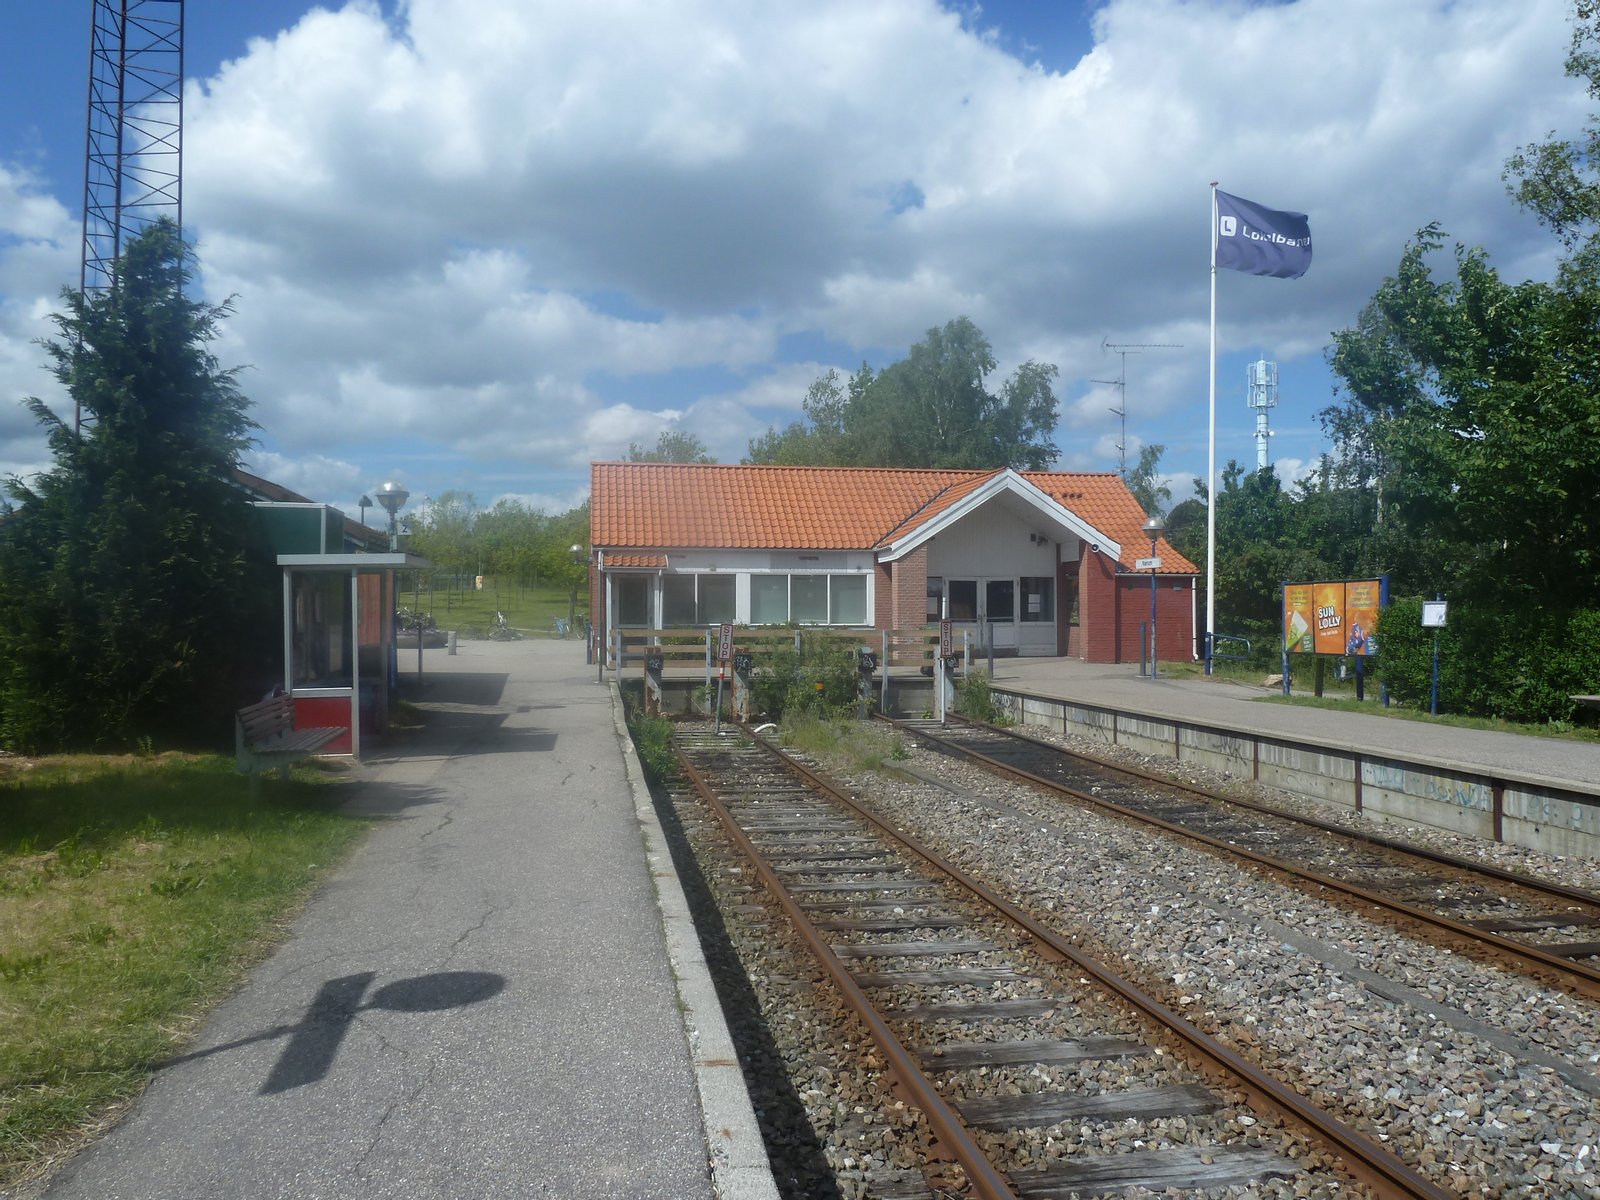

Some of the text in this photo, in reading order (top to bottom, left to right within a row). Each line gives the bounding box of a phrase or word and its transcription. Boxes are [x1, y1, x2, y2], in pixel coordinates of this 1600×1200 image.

[1318, 606, 1335, 619] SUN
[1318, 615, 1342, 630] LOLLY
[721, 626, 731, 658] STOP
[942, 623, 950, 655] STOP
